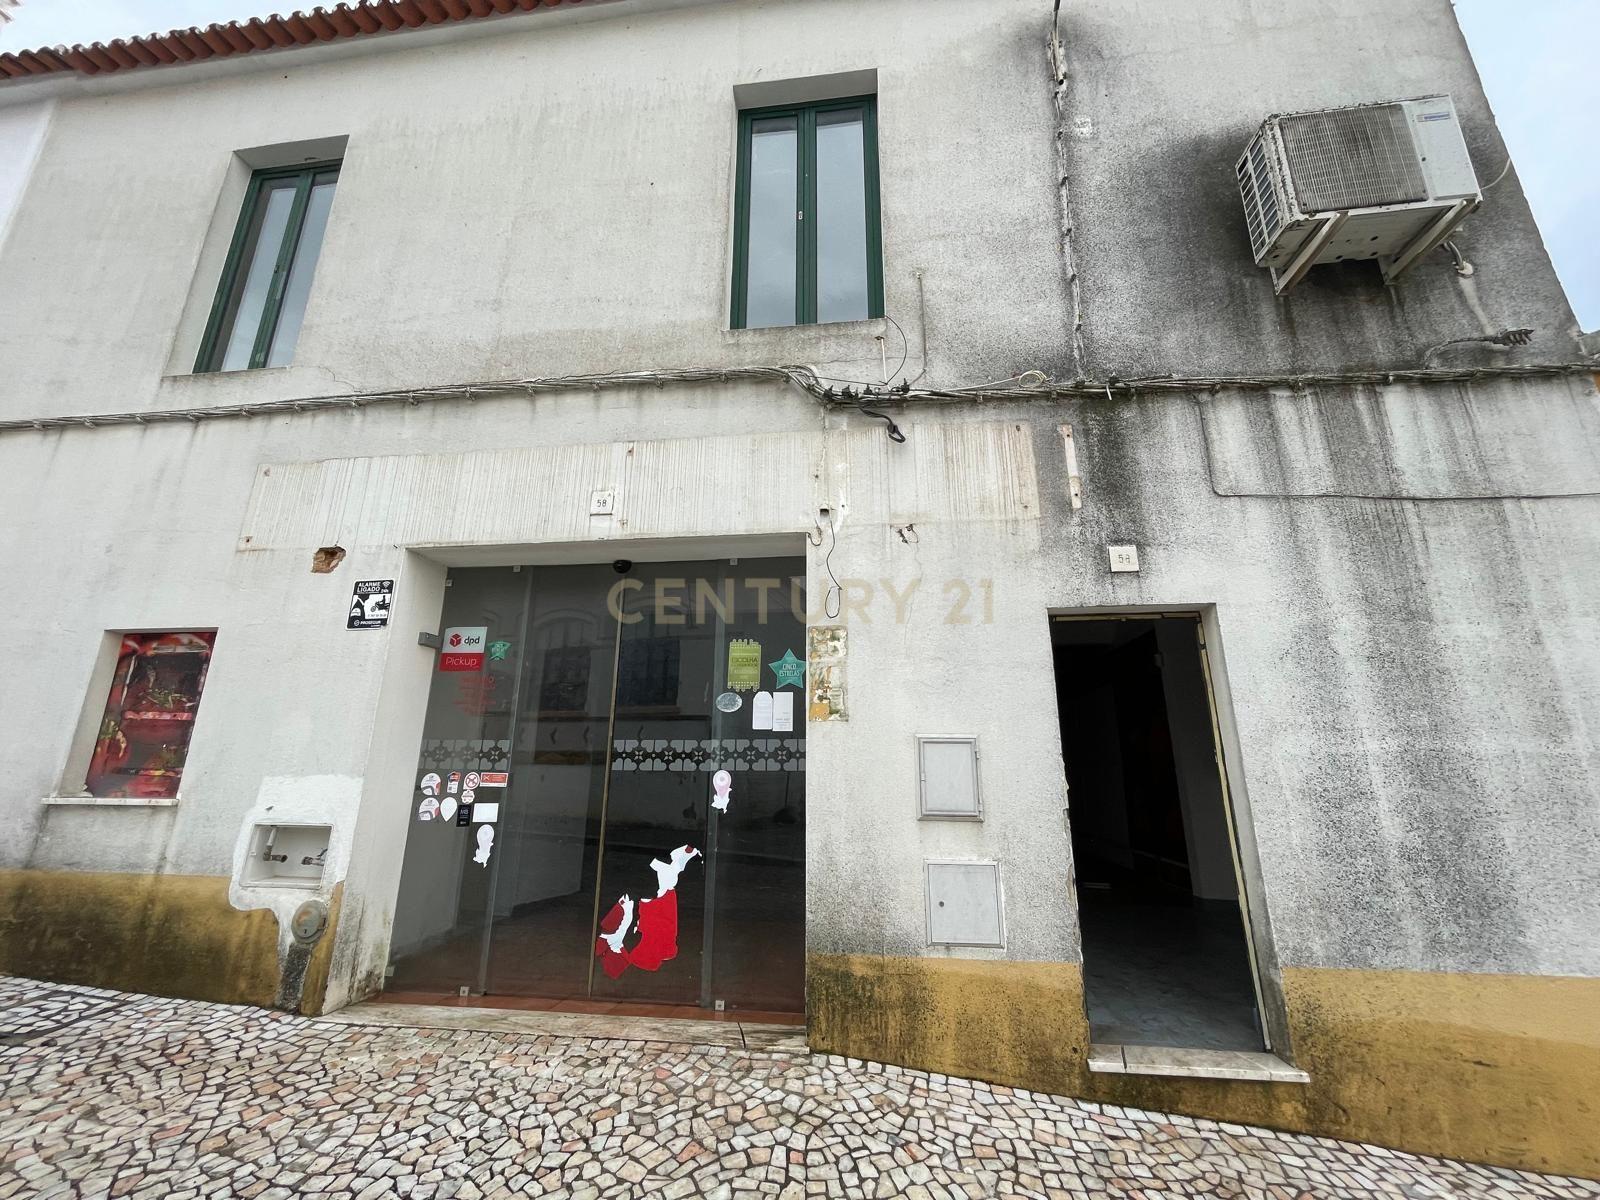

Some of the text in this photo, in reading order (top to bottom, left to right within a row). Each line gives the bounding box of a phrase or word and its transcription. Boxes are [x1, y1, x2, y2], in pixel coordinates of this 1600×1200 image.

[597, 499, 607, 508] 58
[464, 636, 480, 646] dpd
[446, 656, 477, 668] Pickup
[780, 669, 800, 677] ESTRELAS
